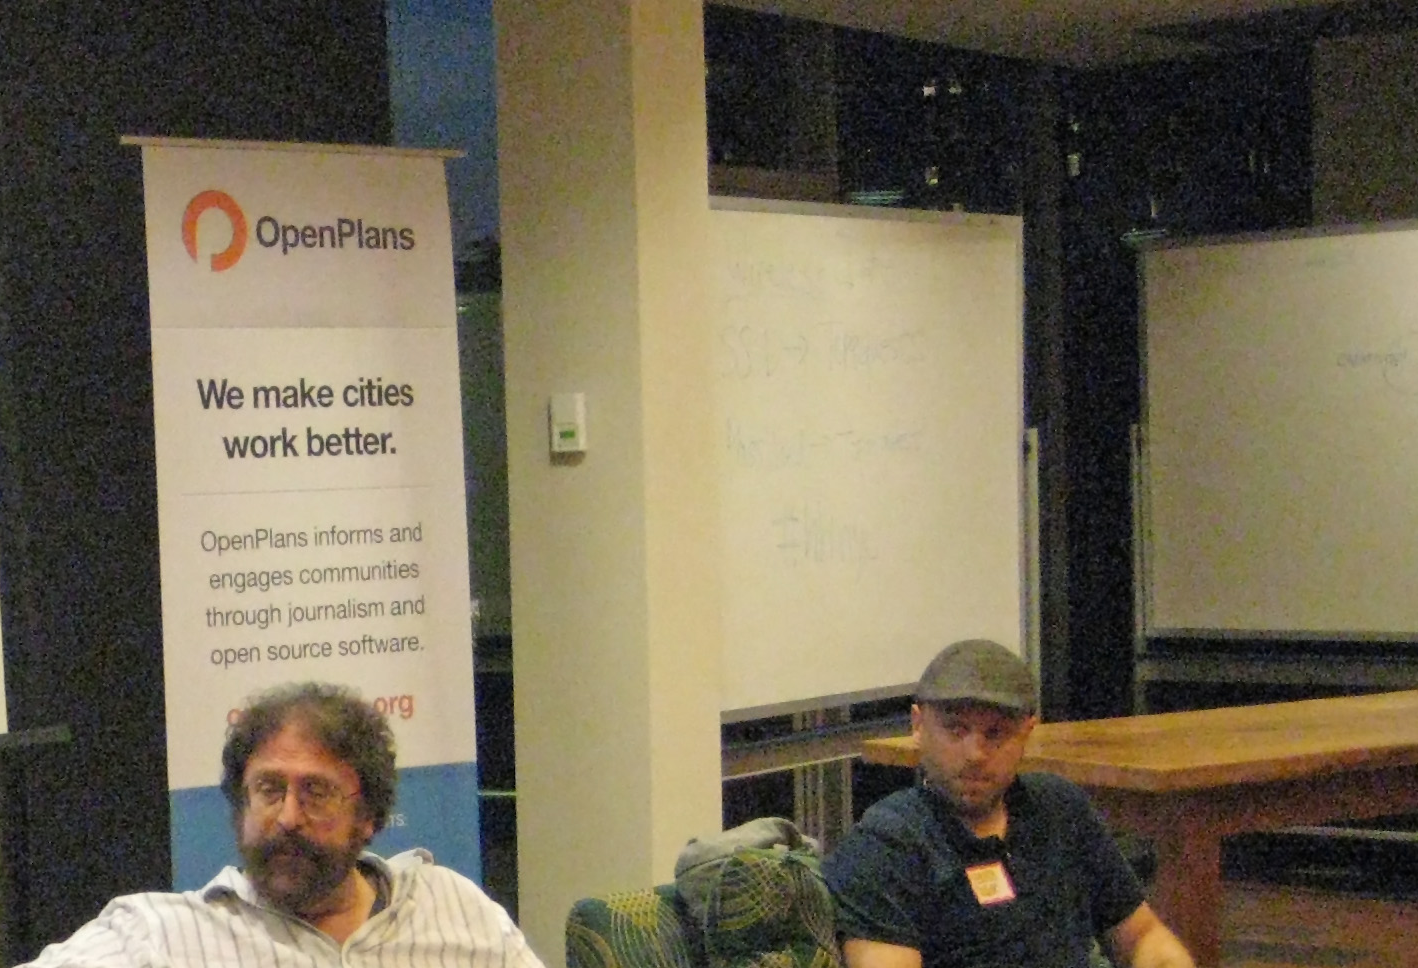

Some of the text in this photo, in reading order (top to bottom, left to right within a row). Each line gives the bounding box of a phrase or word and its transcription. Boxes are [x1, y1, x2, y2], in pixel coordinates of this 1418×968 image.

[255, 215, 415, 255] OpenPlans
[197, 377, 415, 410] We make cities
[223, 427, 397, 459] work better.
[200, 522, 423, 556] OpenPlans informs and
[209, 560, 420, 593] engages communities
[206, 595, 425, 630] through journalism and
[210, 634, 425, 669] open source software.
